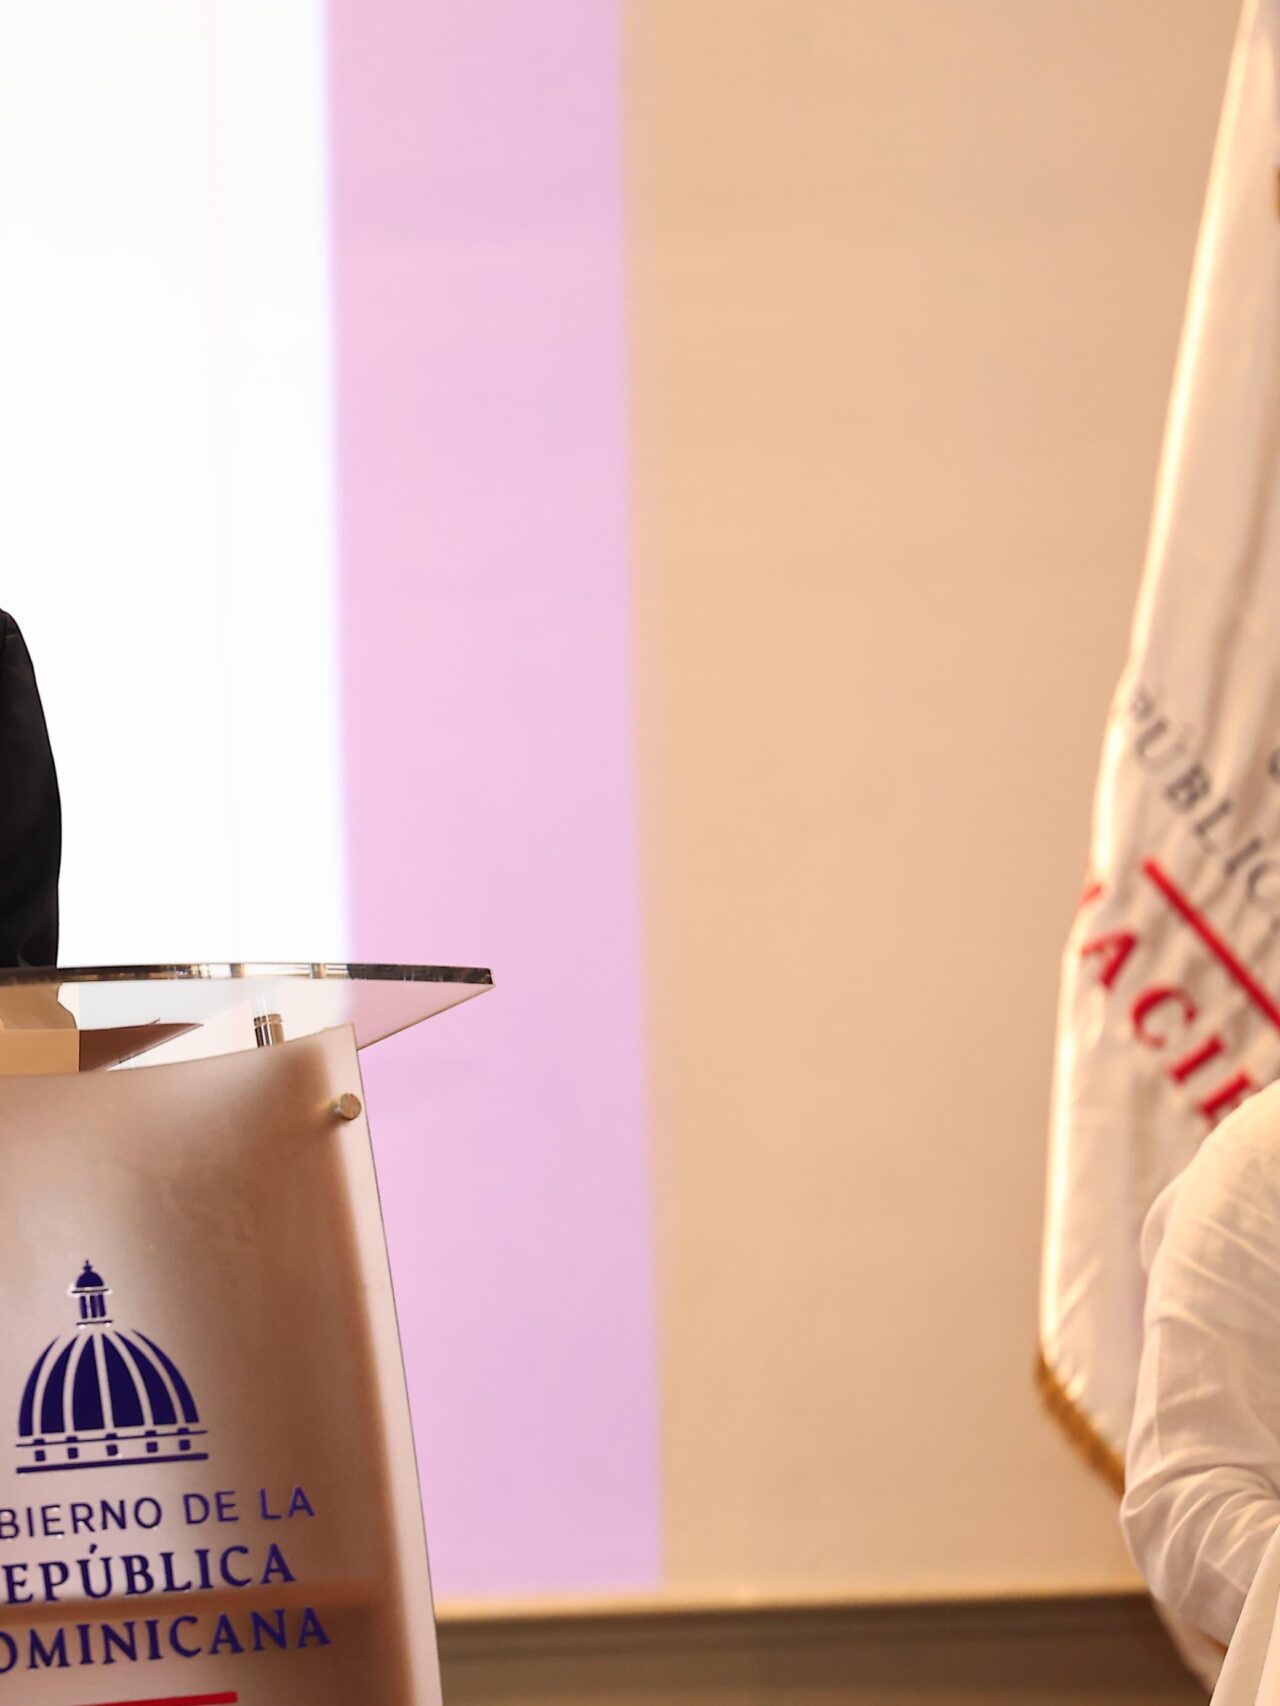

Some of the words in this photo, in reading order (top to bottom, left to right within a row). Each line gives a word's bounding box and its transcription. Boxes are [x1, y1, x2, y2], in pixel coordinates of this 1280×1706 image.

[1078, 882, 1256, 1124] ACI
[182, 1489, 240, 1526] DE
[259, 1485, 317, 1521] LA
